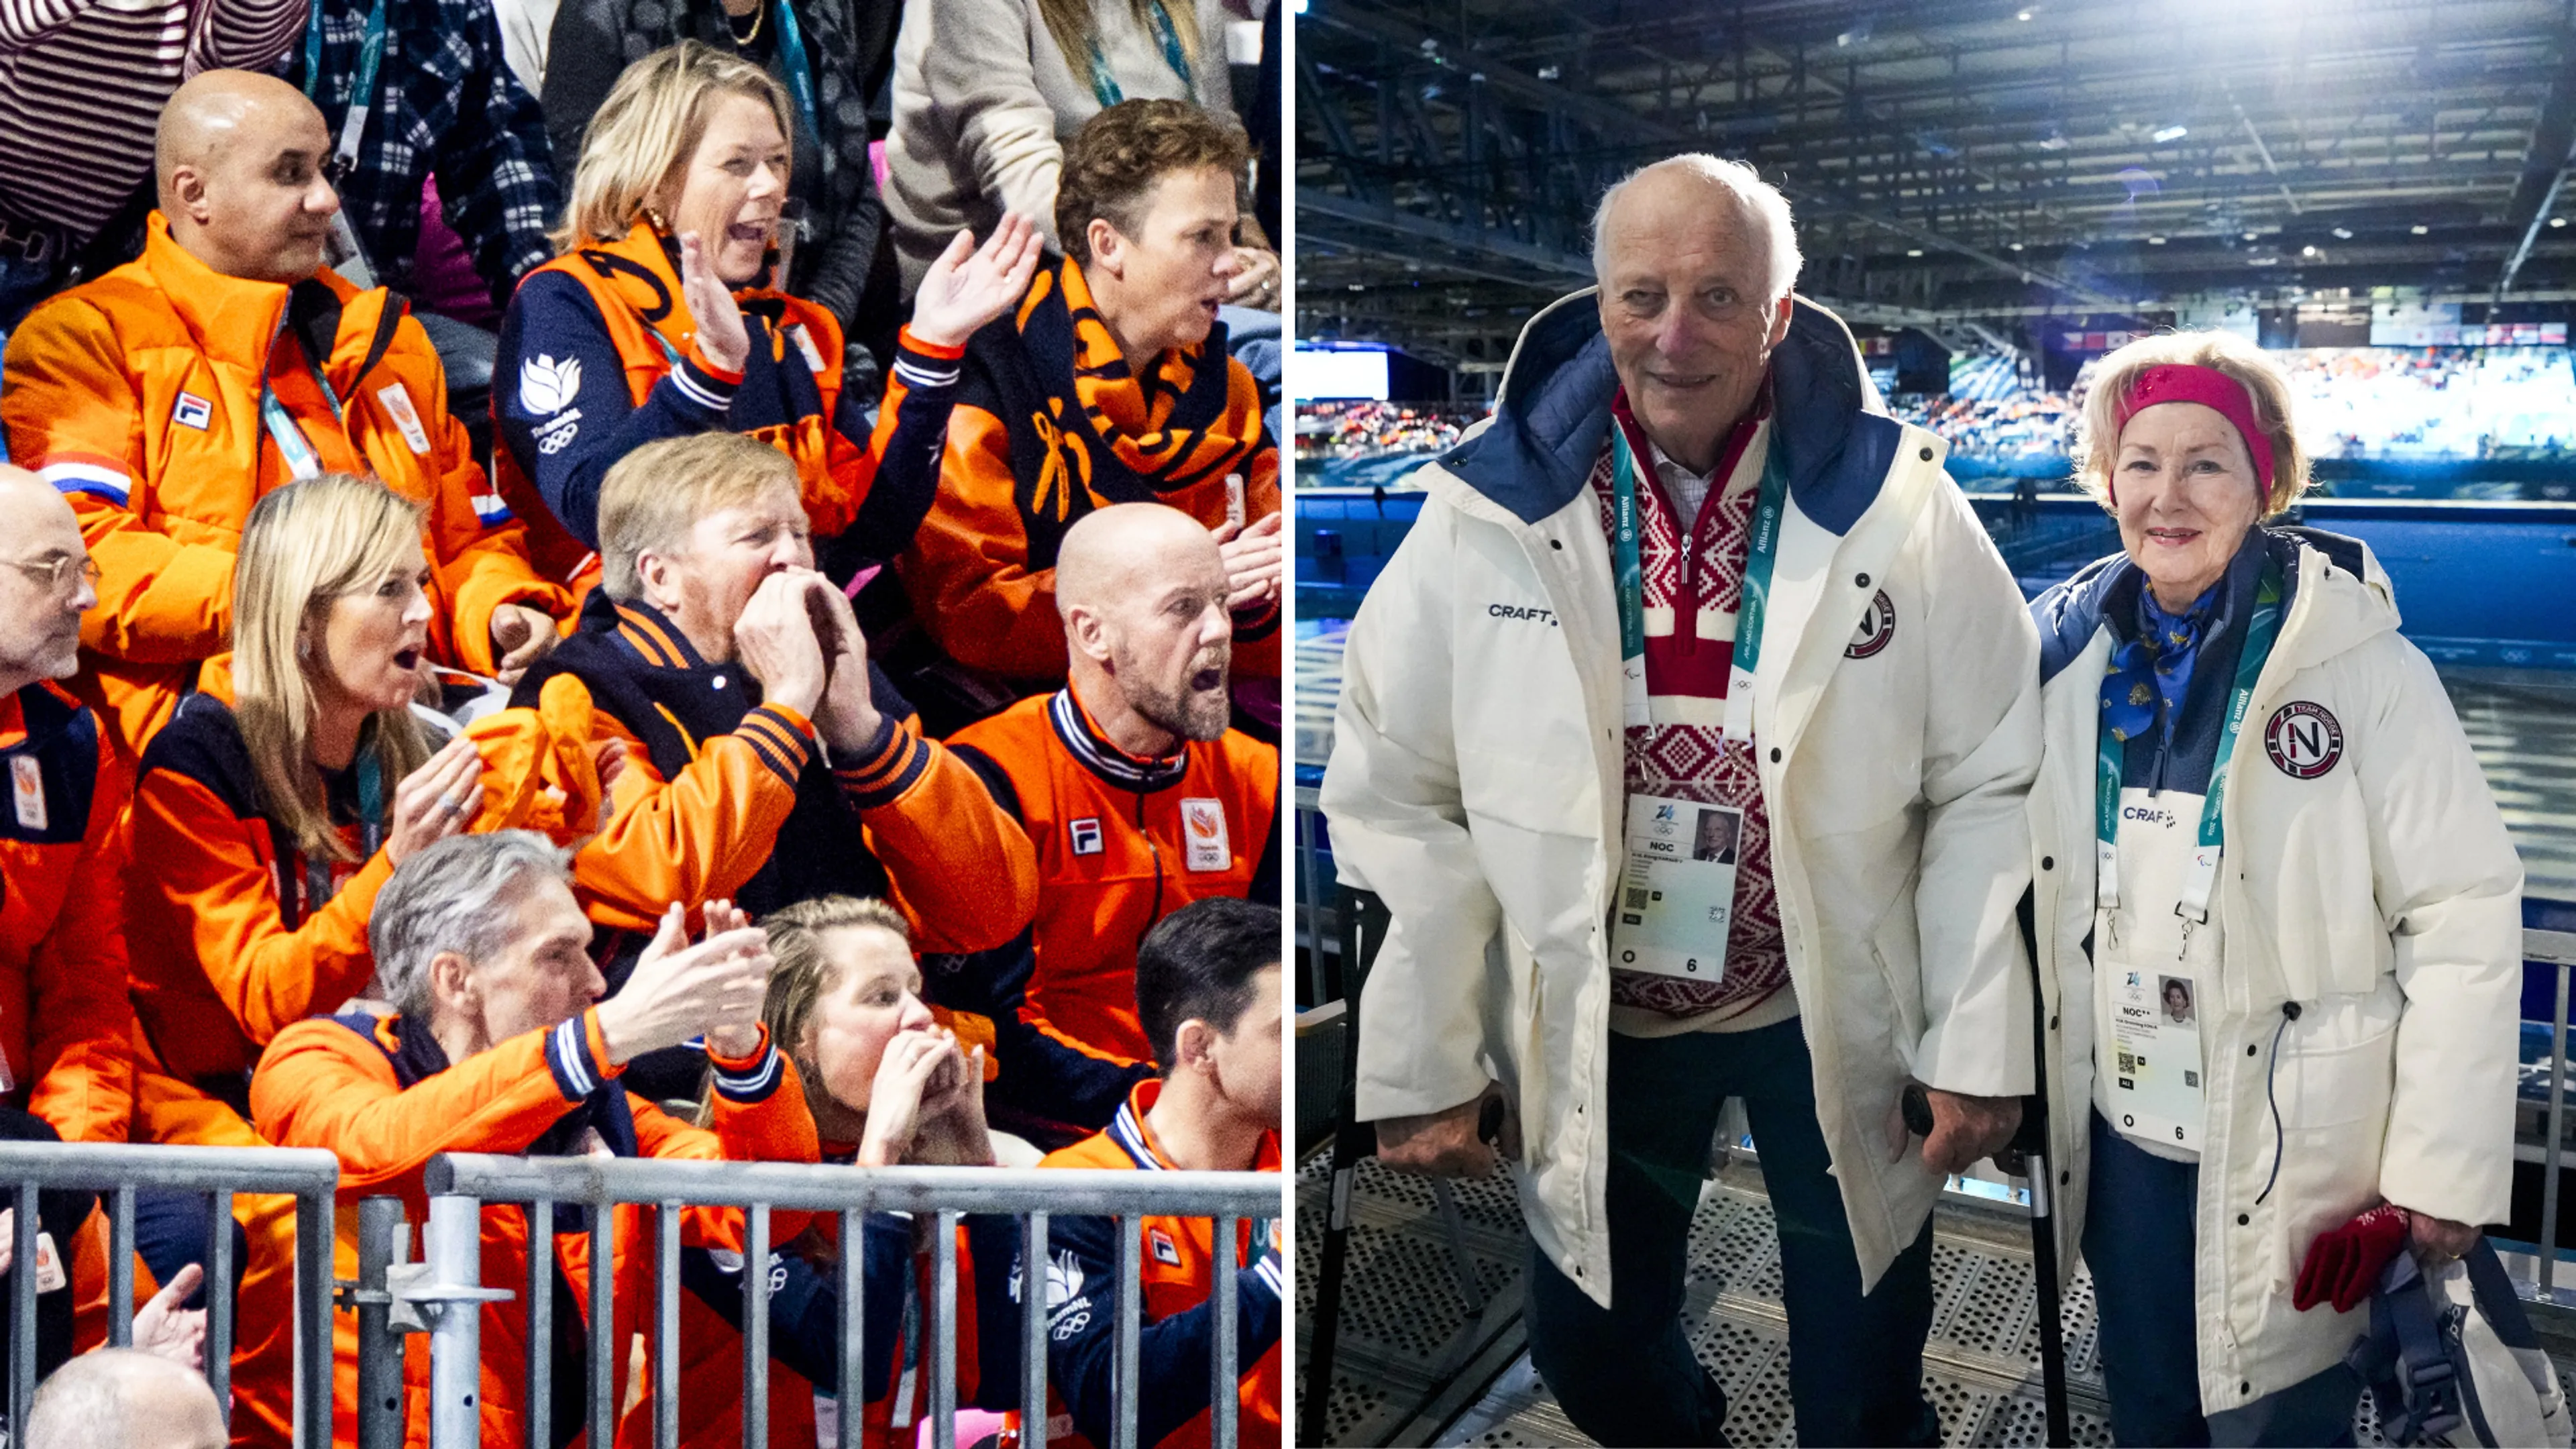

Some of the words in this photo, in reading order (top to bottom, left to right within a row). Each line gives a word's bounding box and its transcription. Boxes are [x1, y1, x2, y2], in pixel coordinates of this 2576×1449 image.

[1621, 496, 1629, 528] Allianz
[1757, 519, 1771, 554] Allianz
[1488, 604, 1552, 623] CRAFT
[2234, 688, 2249, 720] Allianz
[2123, 806, 2165, 823] CRAF
[1650, 841, 1674, 853] NOC
[1686, 958, 1697, 972] 6
[2175, 1126, 2184, 1140] 6
